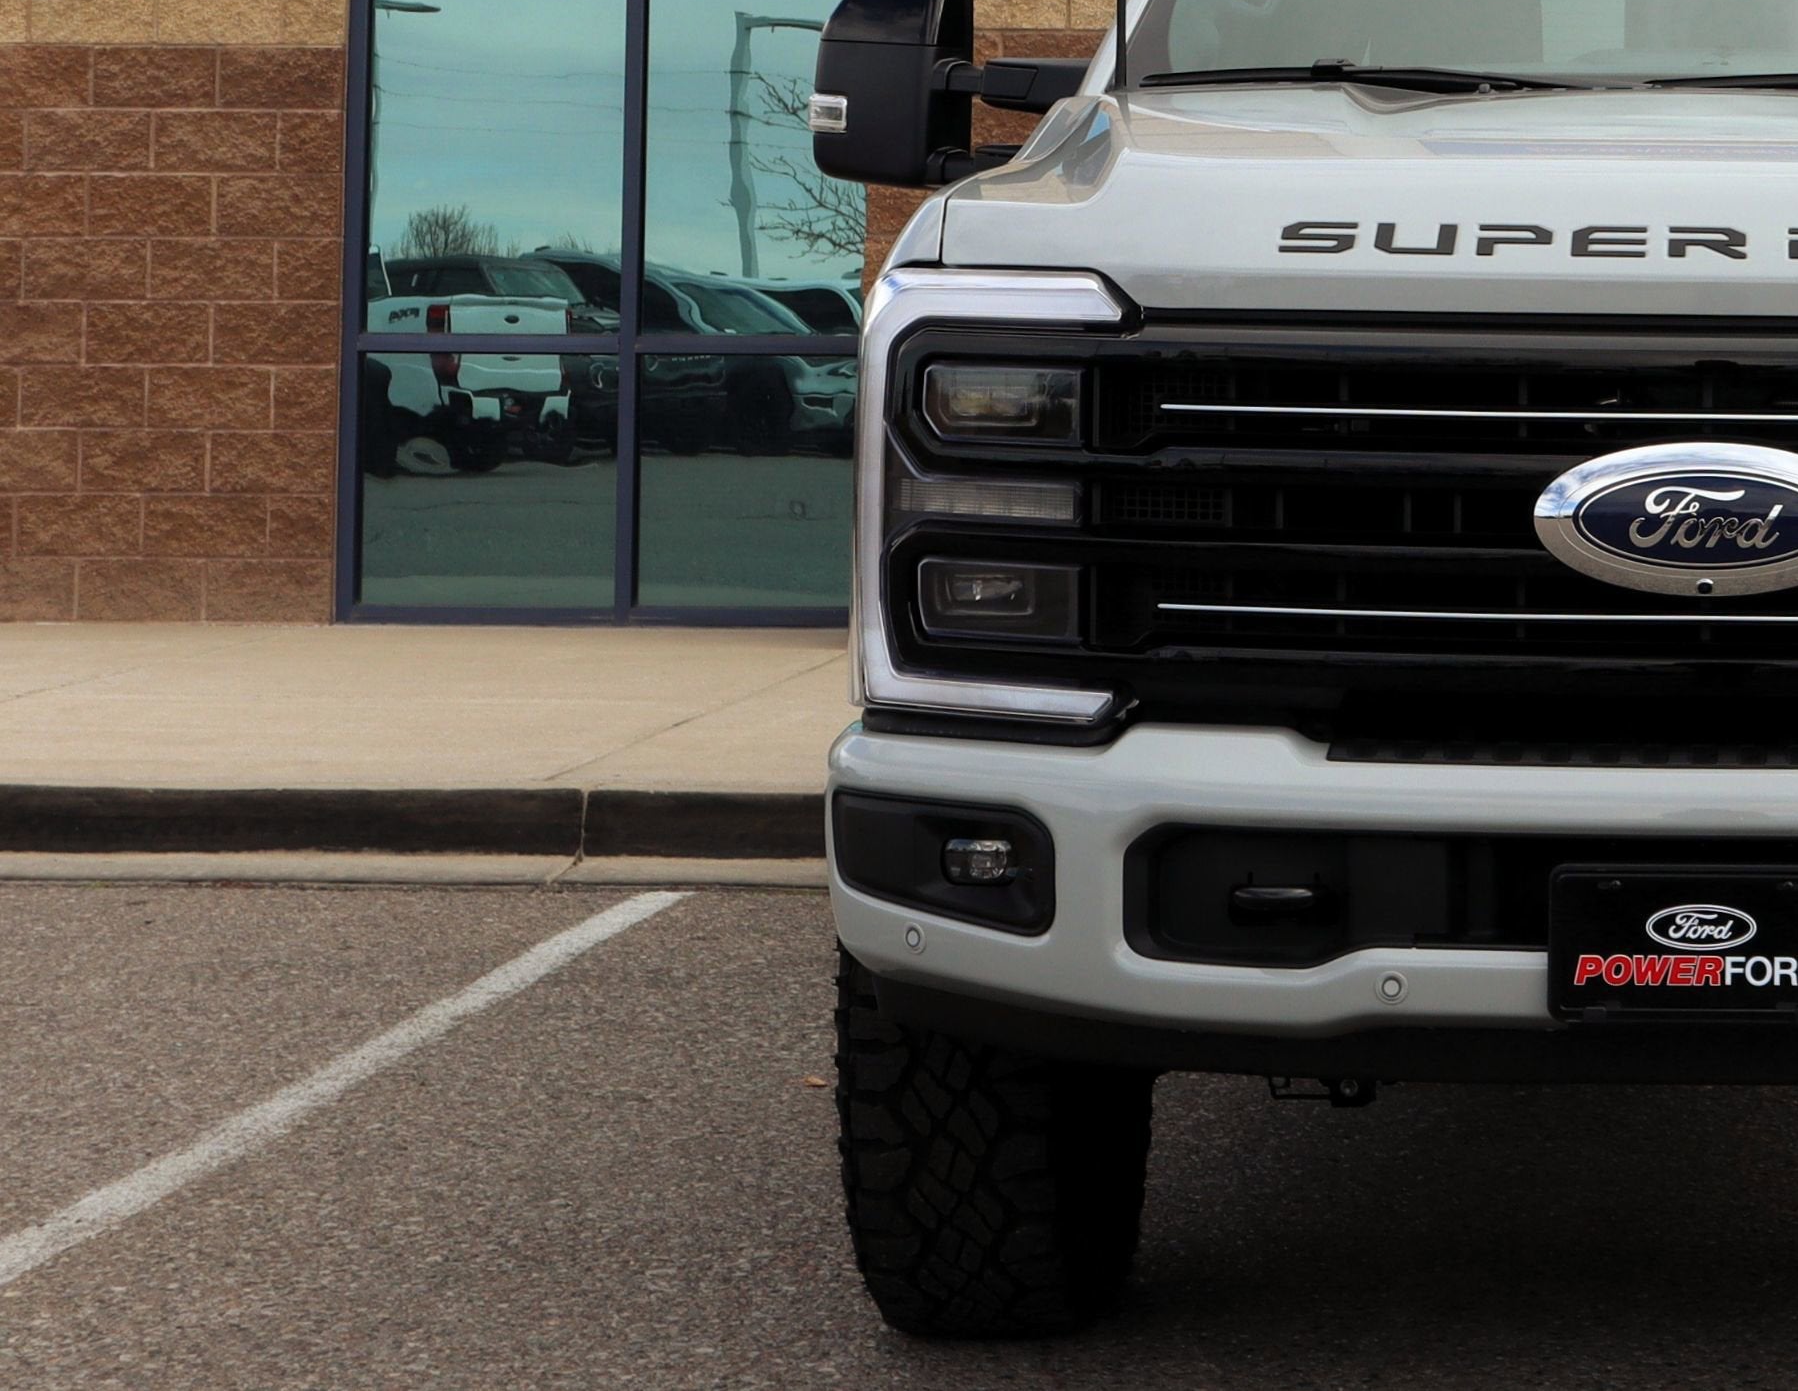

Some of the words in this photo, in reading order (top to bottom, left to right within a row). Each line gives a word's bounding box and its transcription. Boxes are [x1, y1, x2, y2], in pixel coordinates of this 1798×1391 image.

[1278, 221, 1748, 260] SUPER
[1628, 485, 1782, 549] Ford
[1669, 912, 1733, 940] Ford
